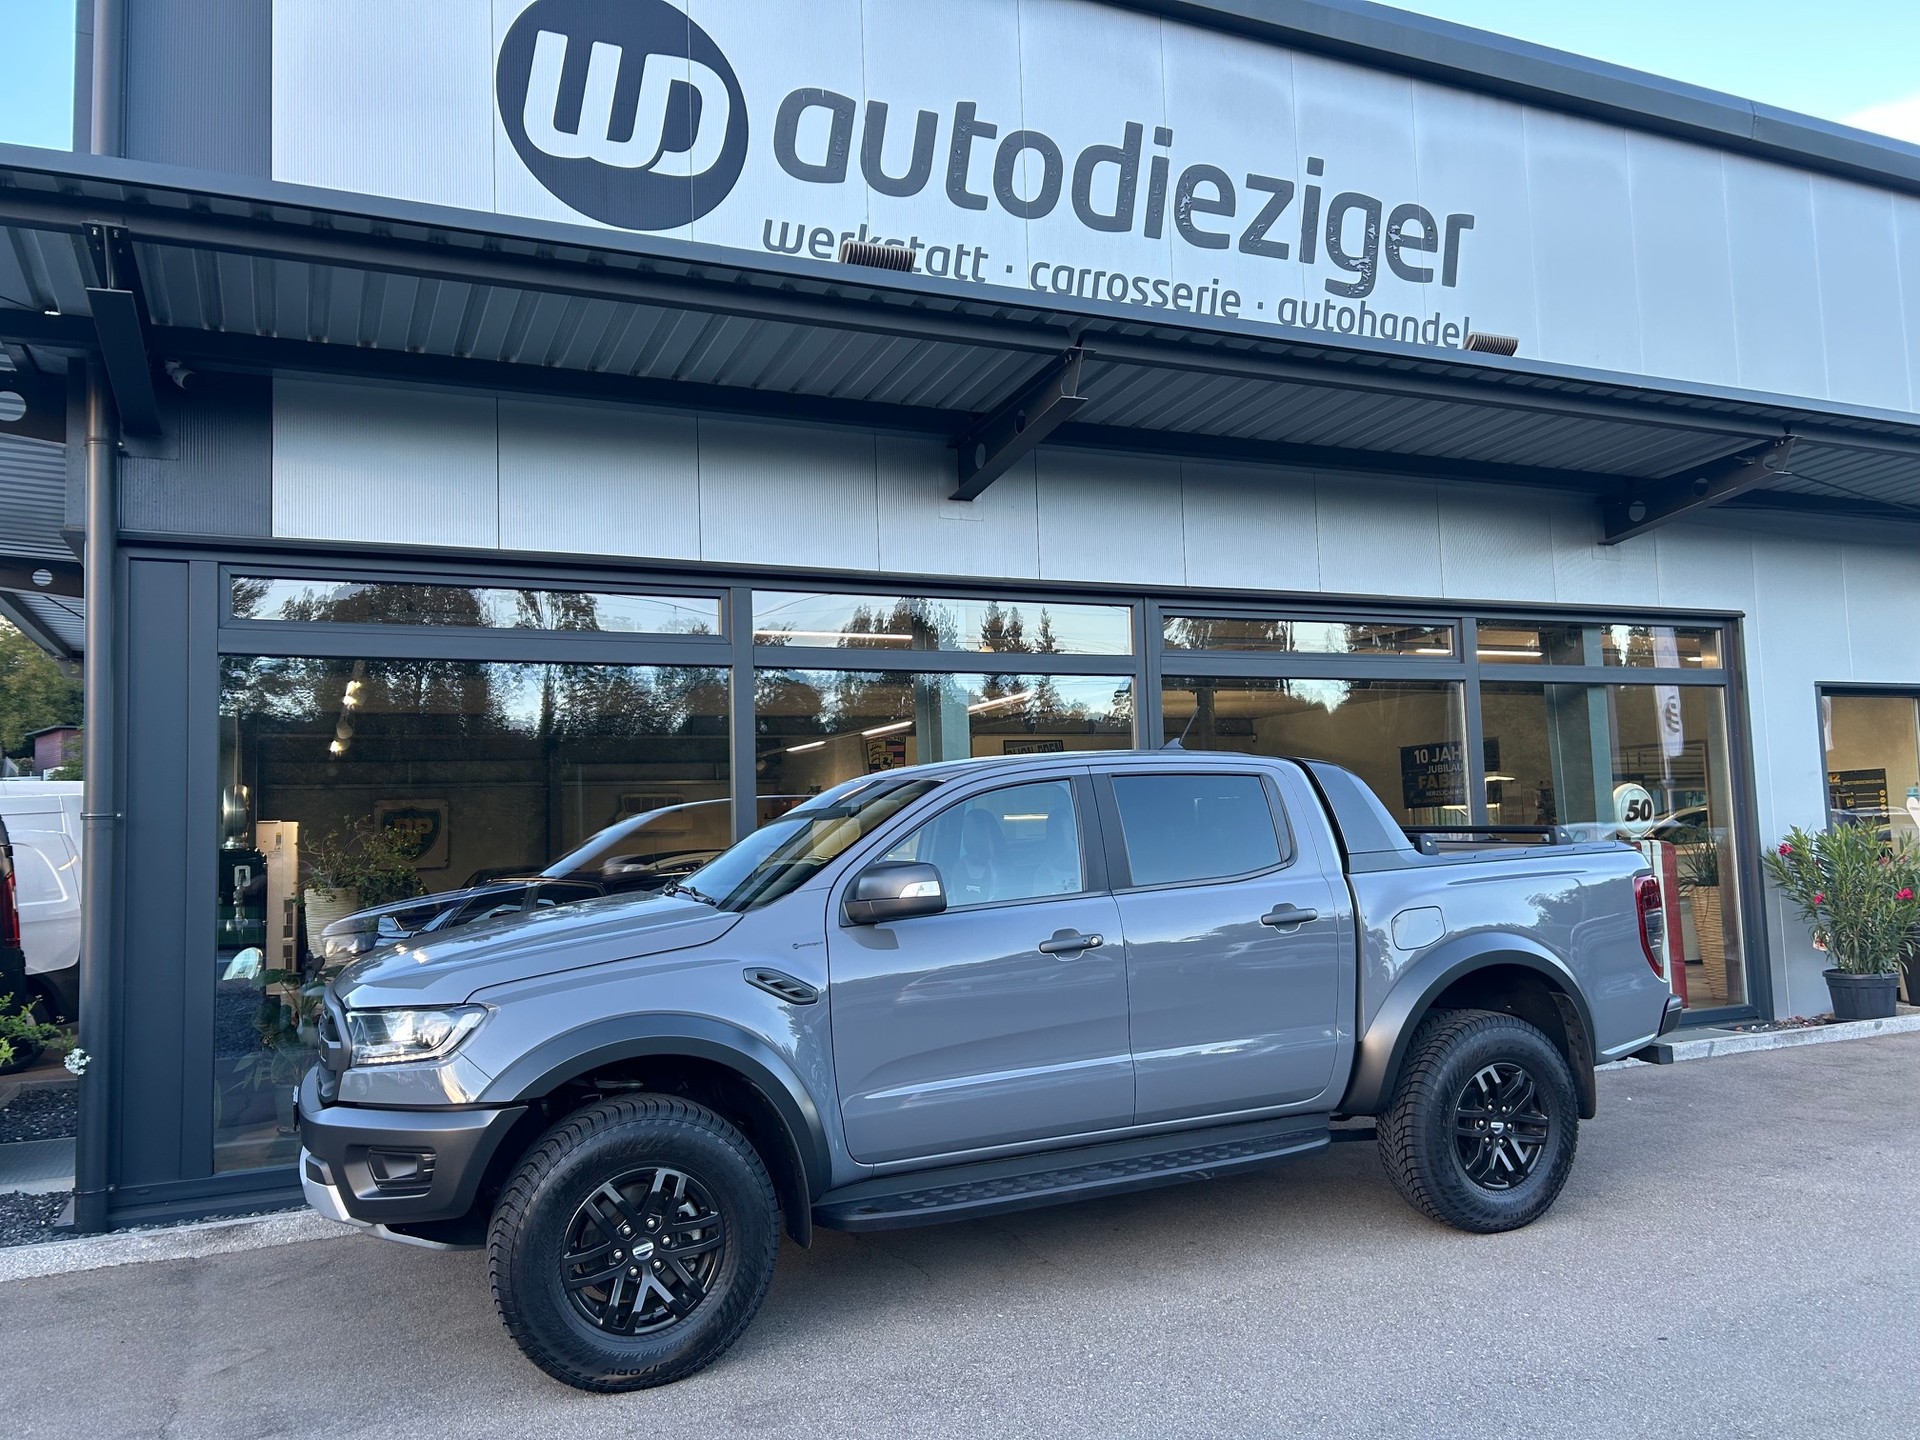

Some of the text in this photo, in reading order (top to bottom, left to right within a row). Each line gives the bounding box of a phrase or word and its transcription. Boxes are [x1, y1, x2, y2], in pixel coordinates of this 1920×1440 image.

[773, 87, 1475, 298] autodieziger
[762, 219, 1470, 350] wertatt carrosserie autohandel
[1413, 744, 1463, 765] 10 JAH
[1625, 799, 1653, 822] 50
